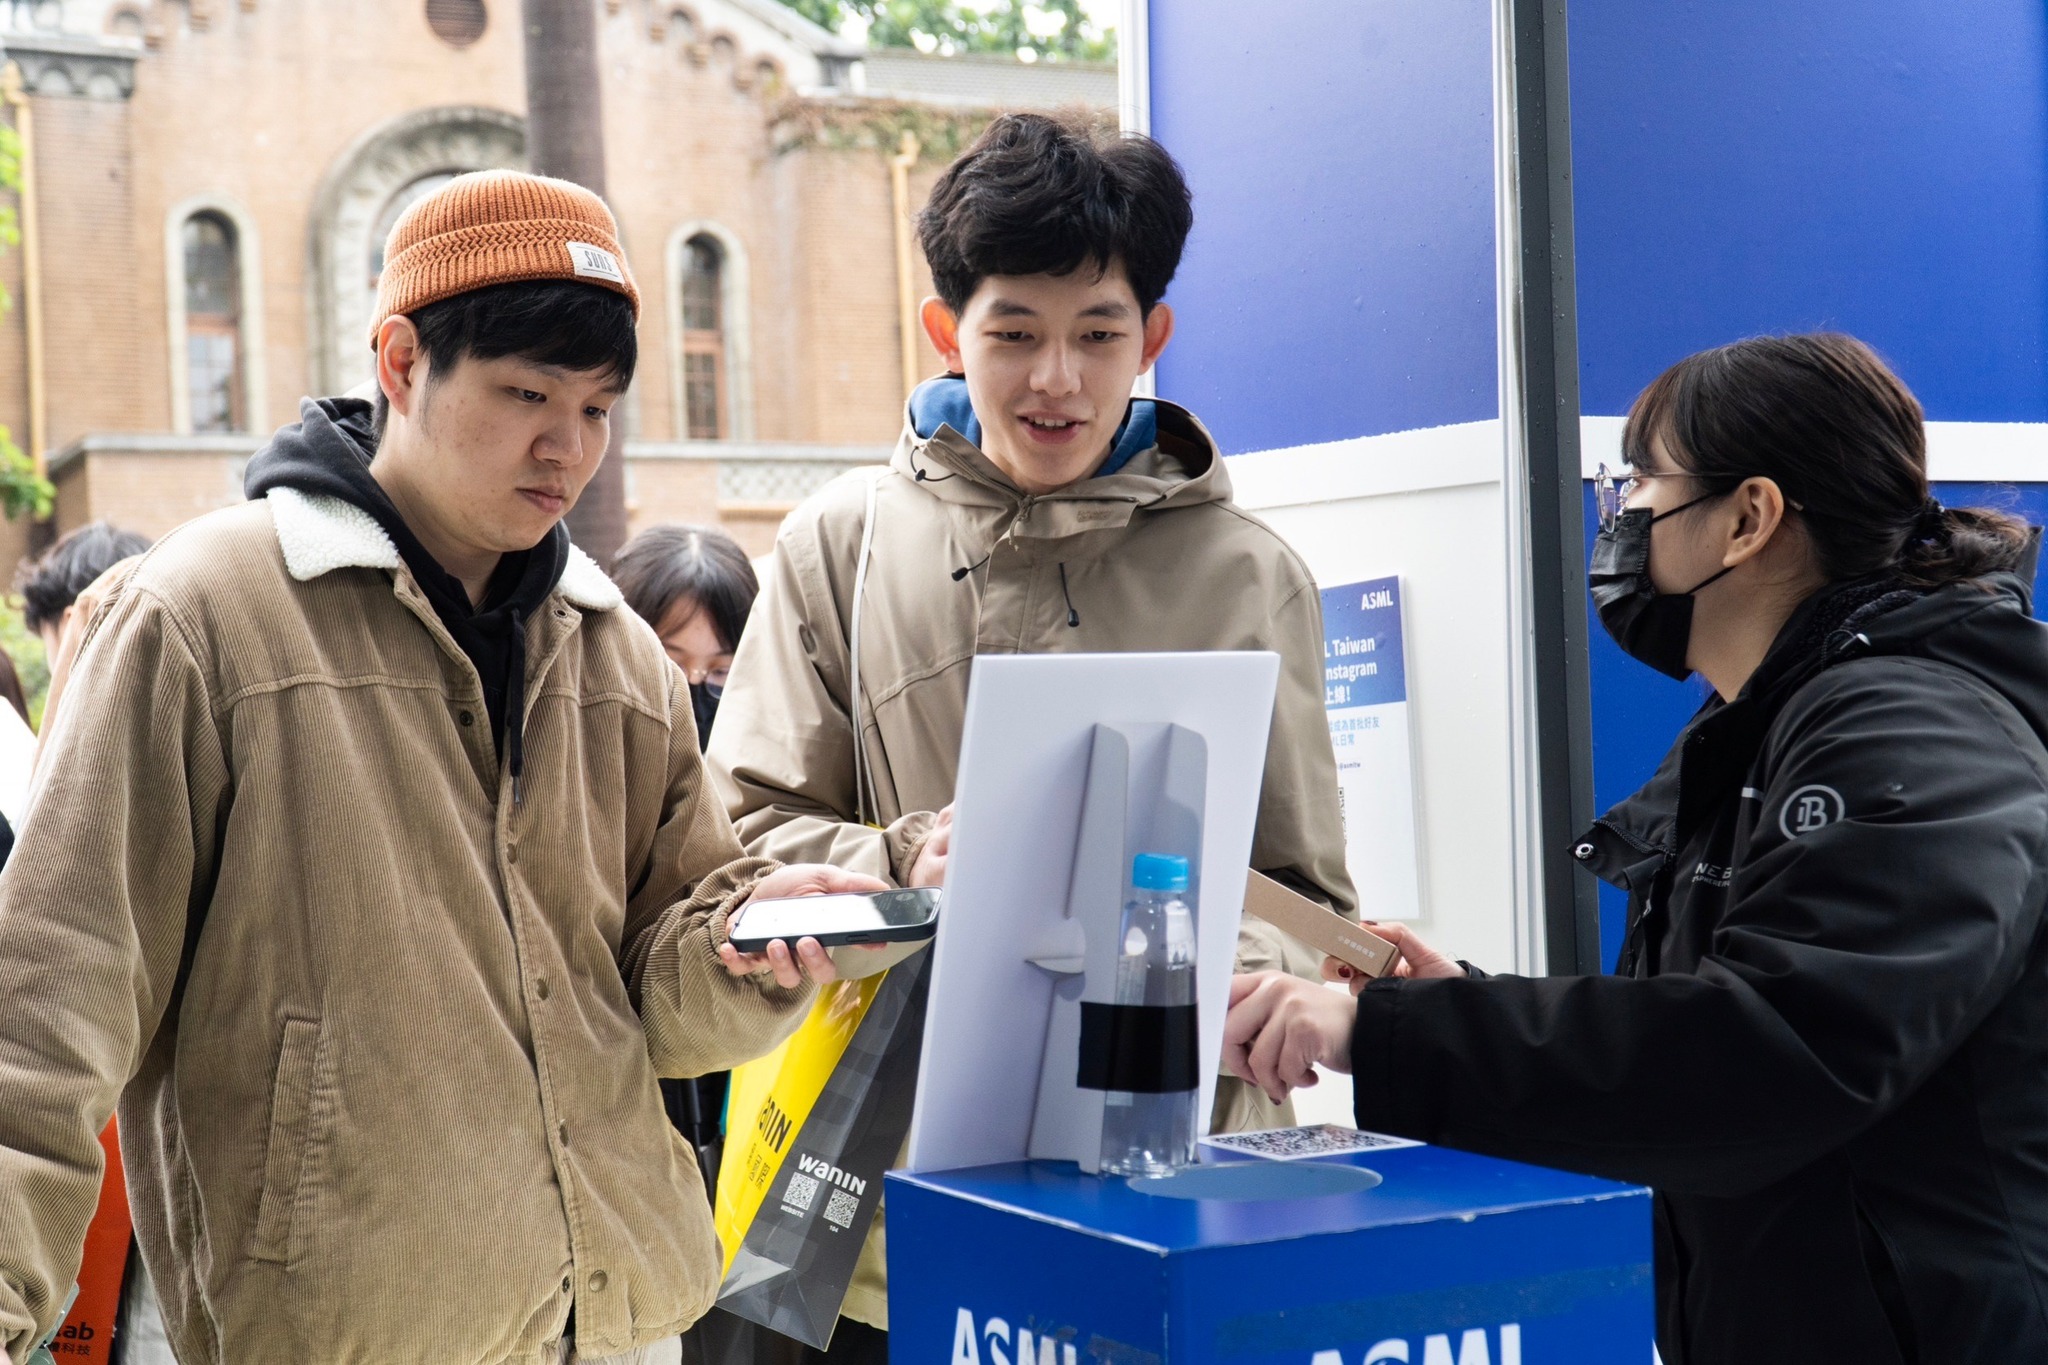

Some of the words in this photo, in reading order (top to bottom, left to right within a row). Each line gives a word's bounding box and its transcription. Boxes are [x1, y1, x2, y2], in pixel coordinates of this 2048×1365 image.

[1361, 590, 1394, 610] ASML
[1332, 636, 1376, 657] Taiwan
[1326, 662, 1378, 682] nstagram
[56, 1321, 95, 1341] ab
